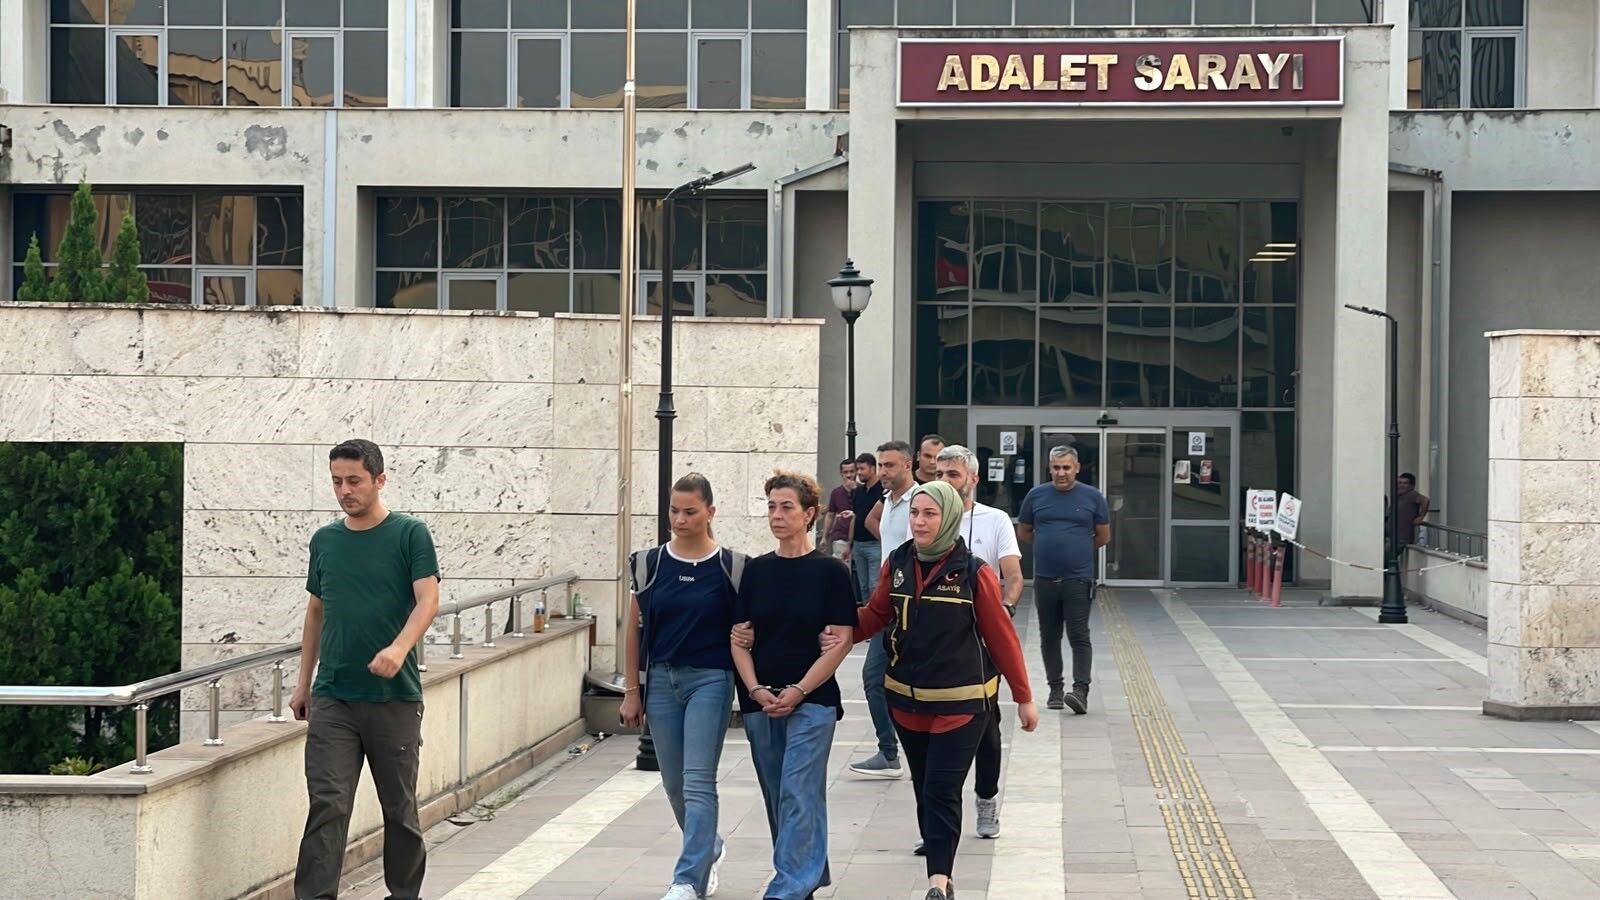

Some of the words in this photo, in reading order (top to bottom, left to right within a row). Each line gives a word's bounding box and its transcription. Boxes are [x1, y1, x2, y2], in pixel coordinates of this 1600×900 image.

[936, 54, 1118, 91] ADALET
[1133, 53, 1304, 92] SARAYI
[936, 584, 961, 594] ASAYİŞ
